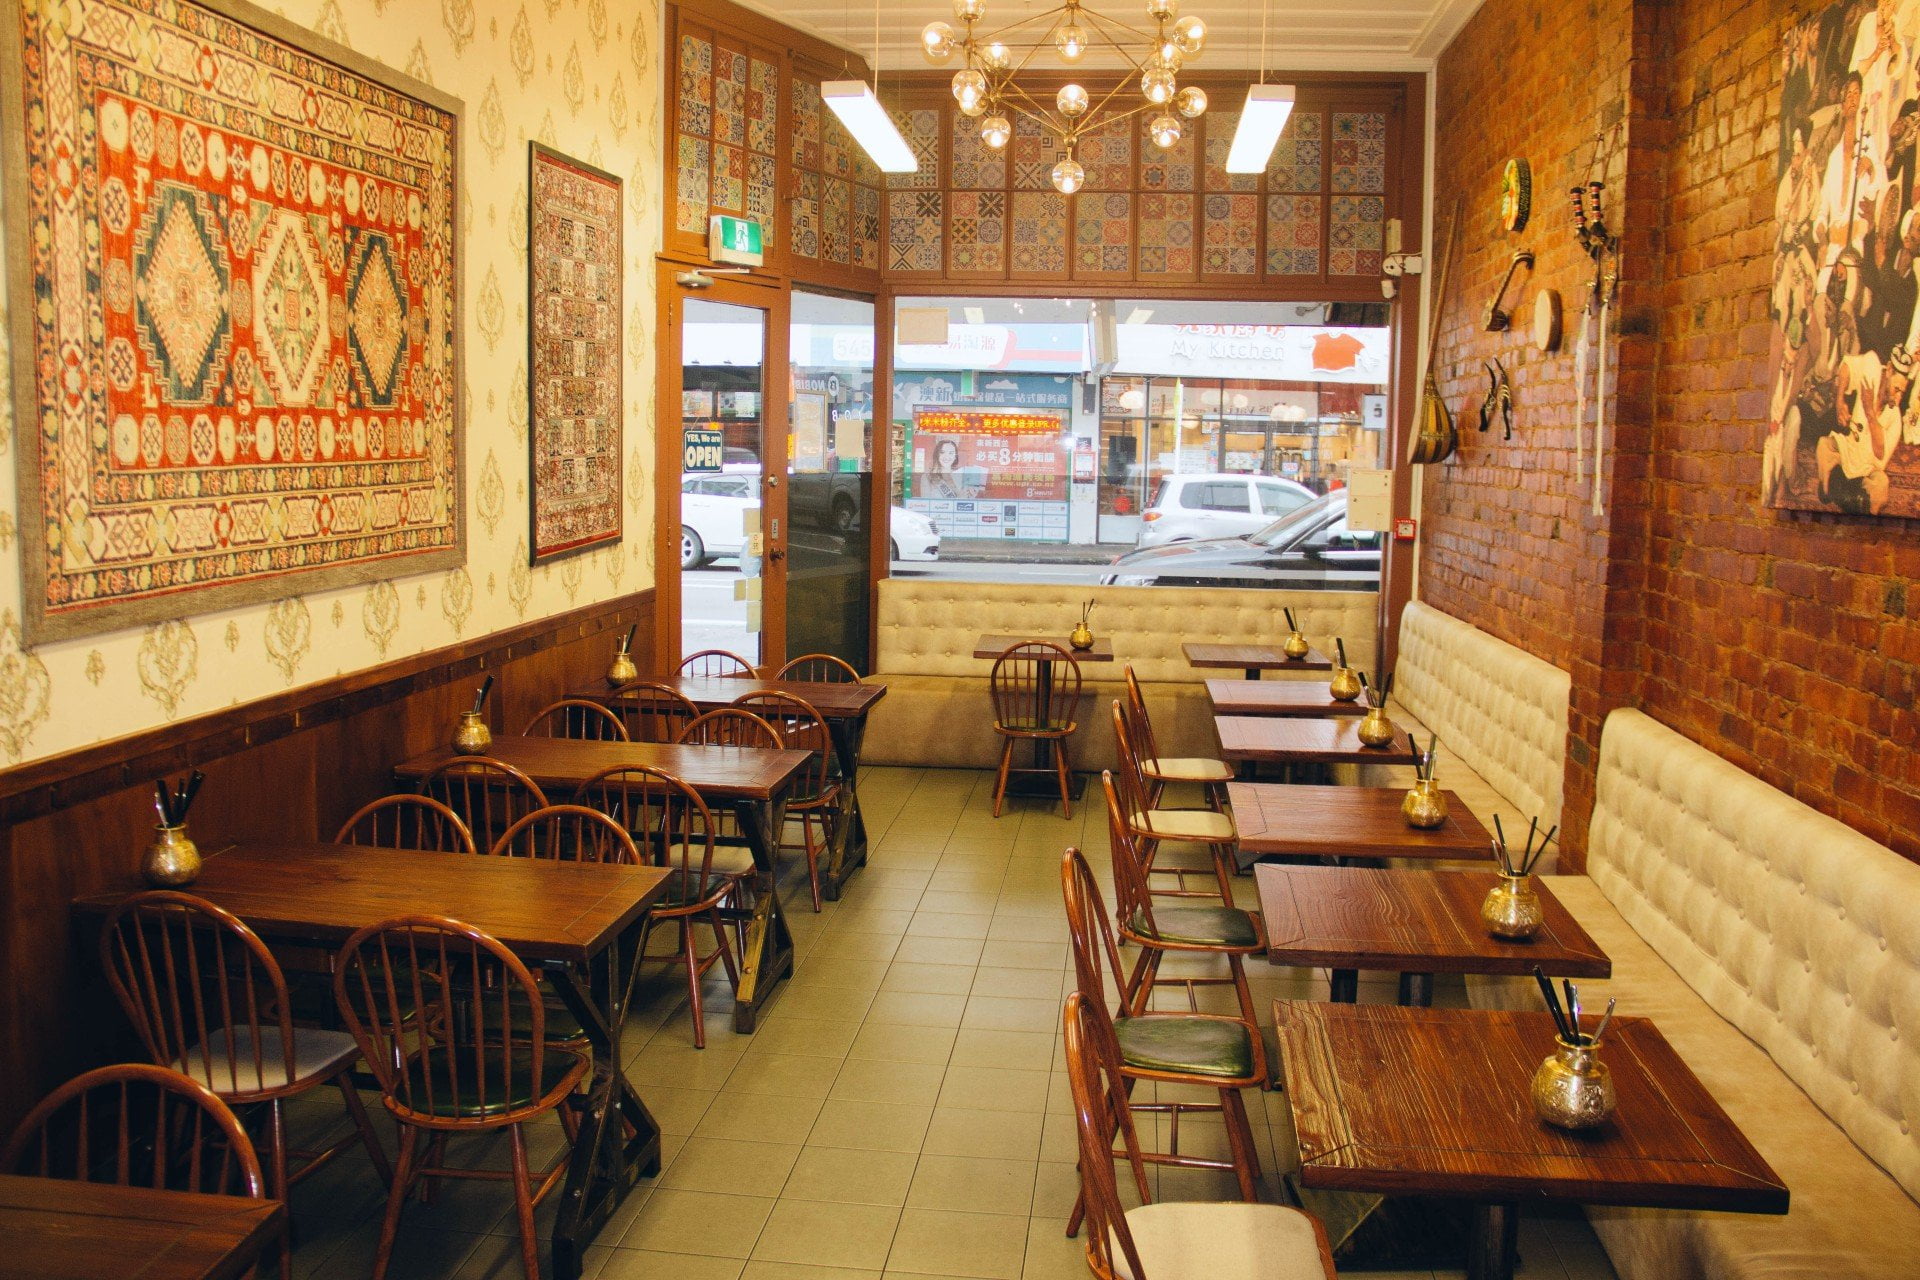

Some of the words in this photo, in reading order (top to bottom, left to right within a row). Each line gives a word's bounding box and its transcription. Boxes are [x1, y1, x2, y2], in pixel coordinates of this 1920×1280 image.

[1171, 340, 1198, 359] My
[1210, 341, 1285, 359] Kitchen
[687, 433, 700, 444] YES,
[701, 433, 710, 442] We
[687, 446, 721, 467] OPEN
